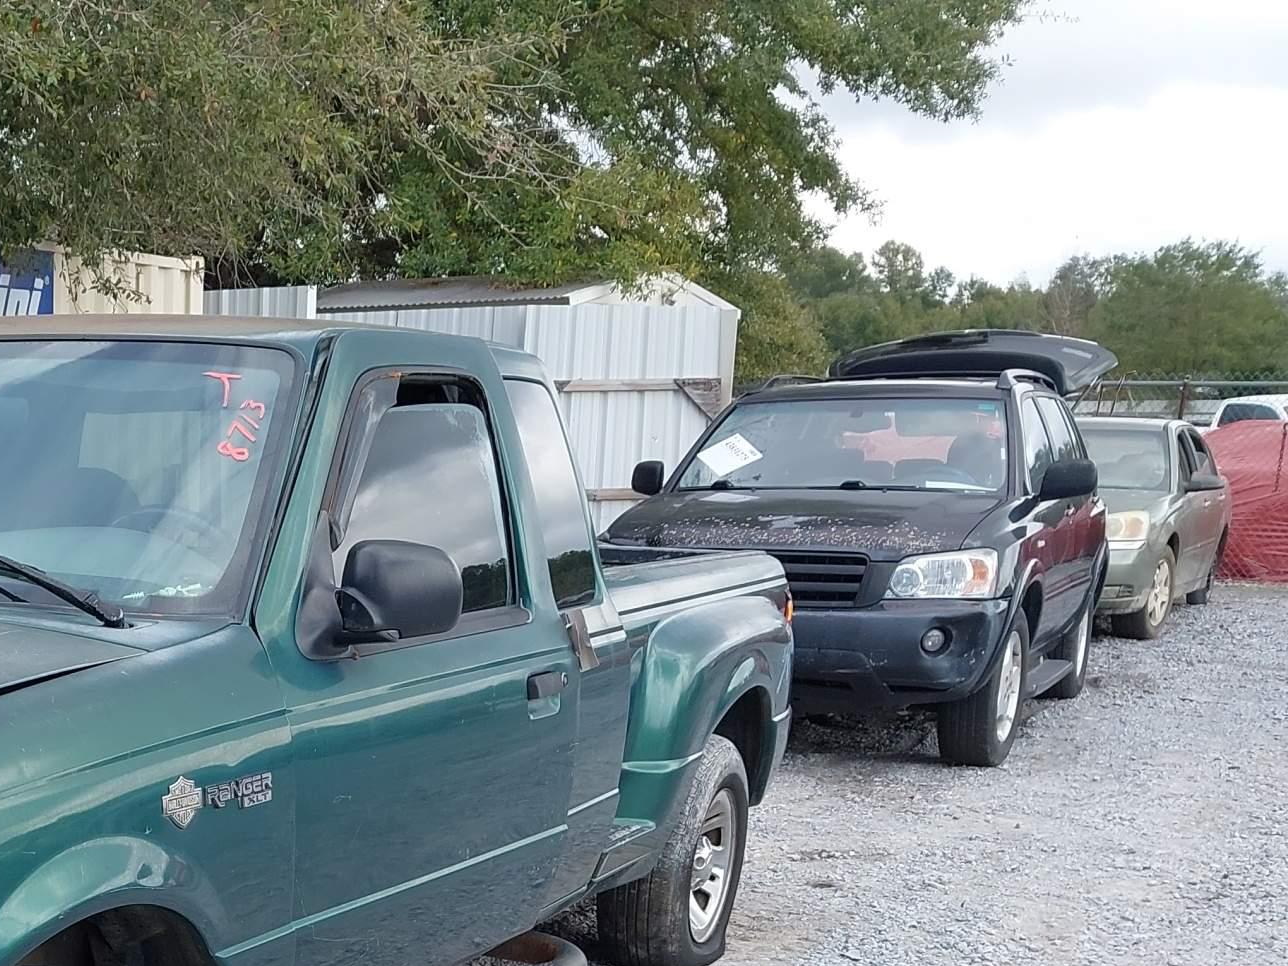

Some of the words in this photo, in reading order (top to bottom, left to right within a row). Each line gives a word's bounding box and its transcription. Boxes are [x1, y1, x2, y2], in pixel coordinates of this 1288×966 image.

[201, 371, 243, 408] T
[217, 399, 266, 462] 8713
[207, 771, 273, 808] RANGER
